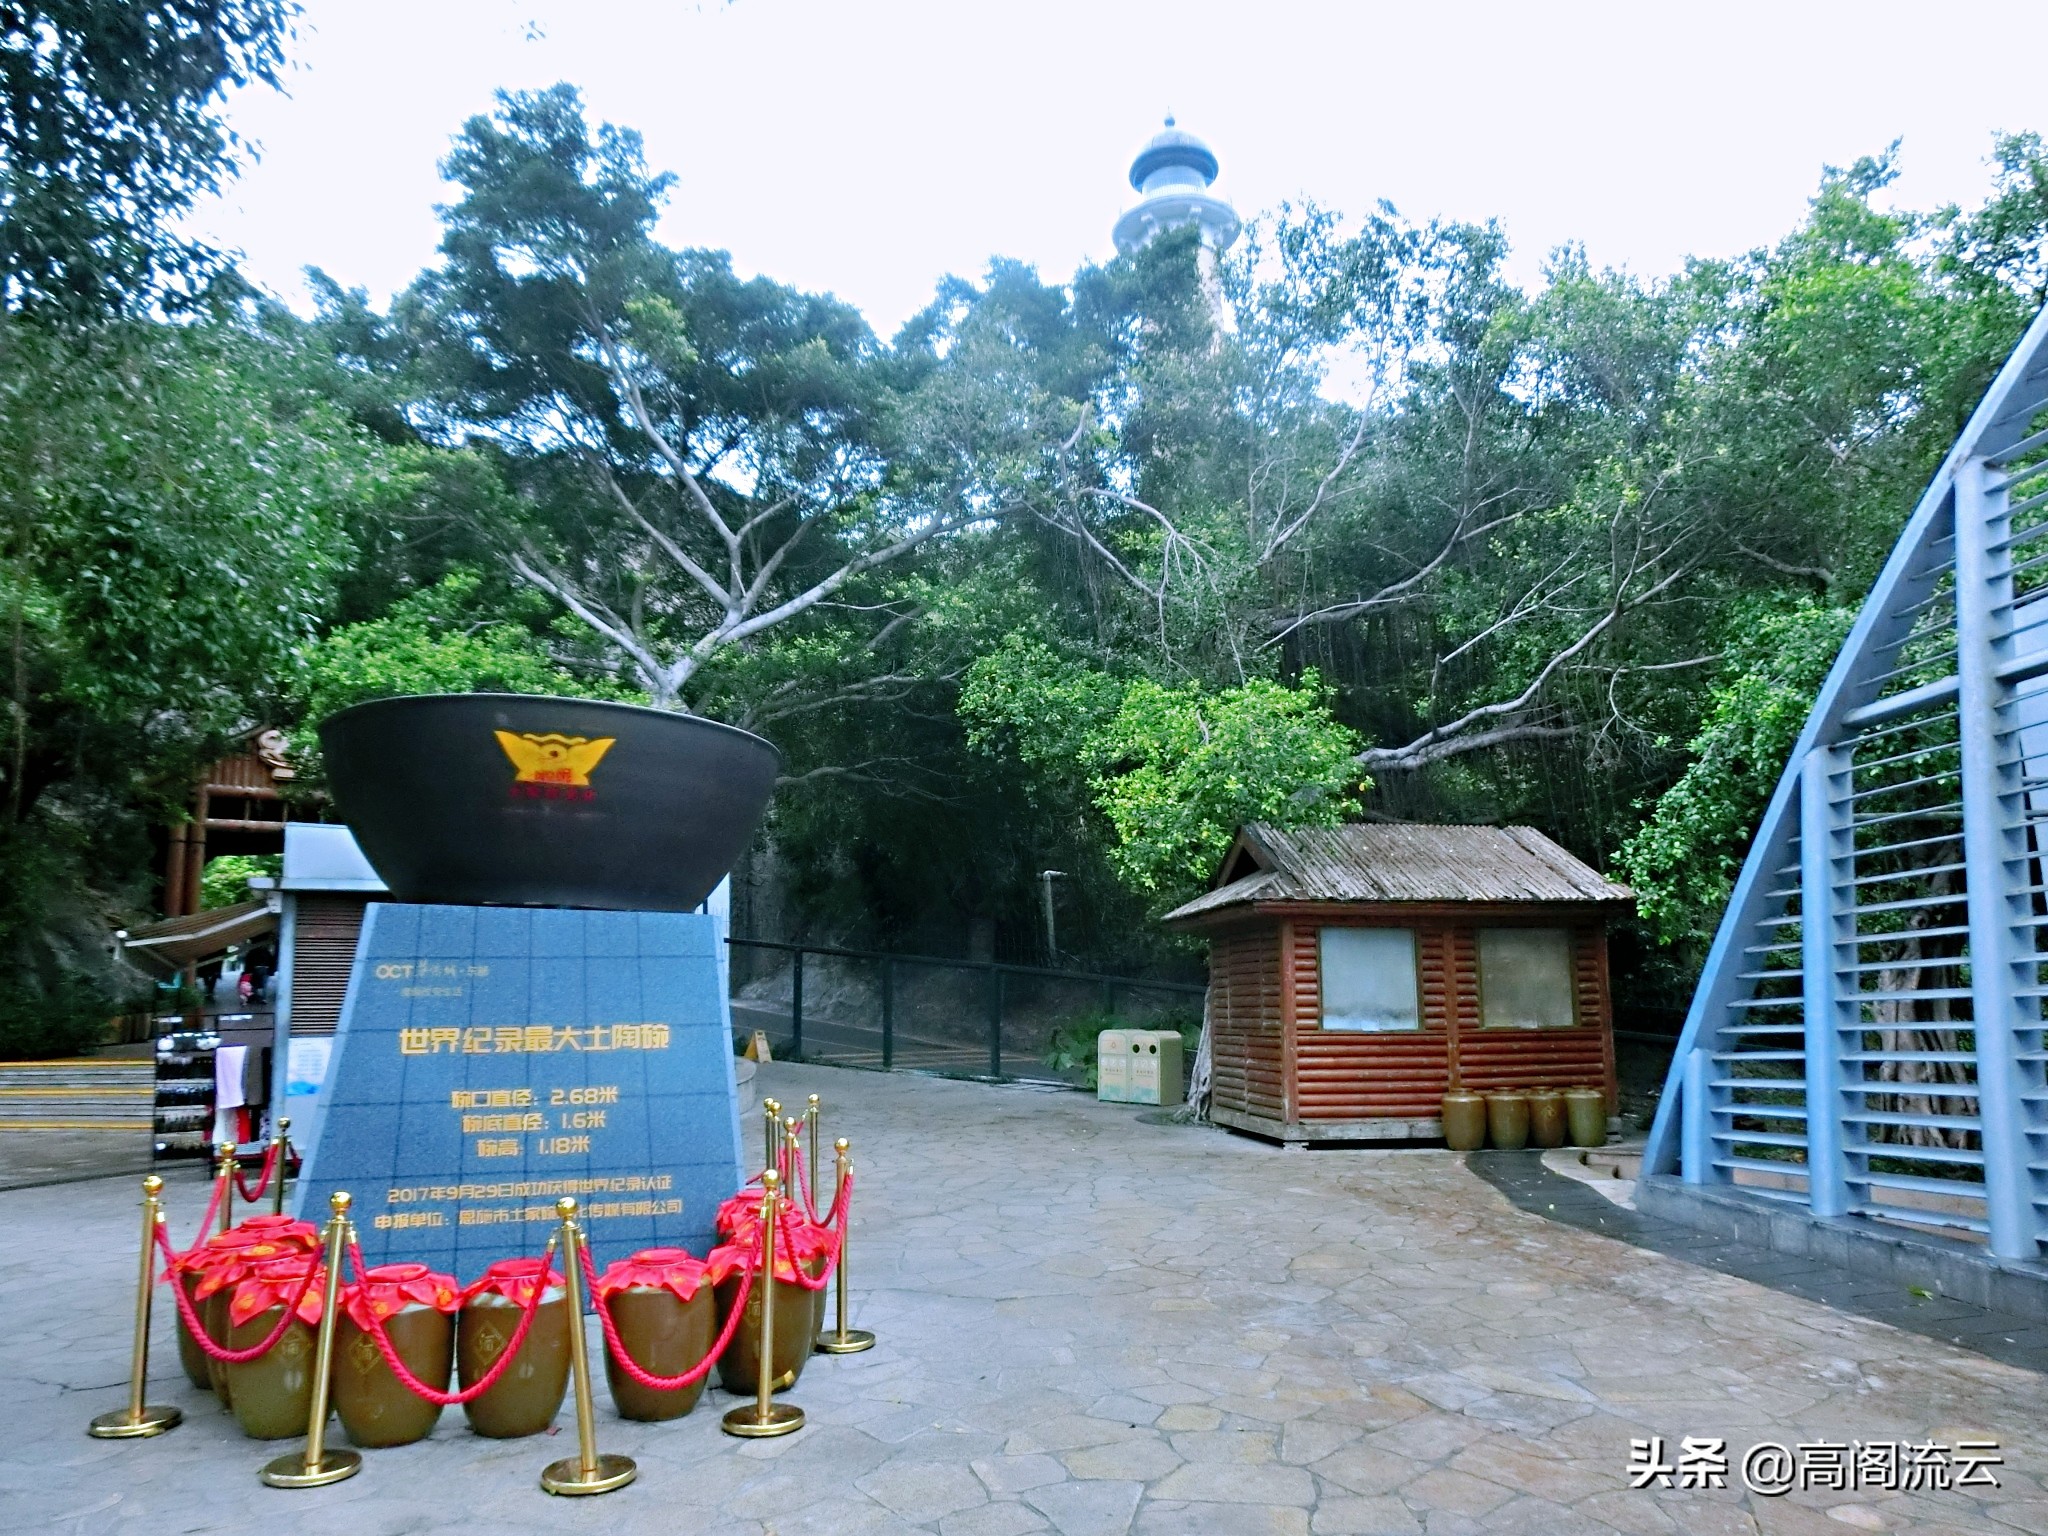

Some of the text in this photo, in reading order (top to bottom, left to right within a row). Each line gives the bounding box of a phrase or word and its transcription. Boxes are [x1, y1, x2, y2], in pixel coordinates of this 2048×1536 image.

[376, 964, 414, 979] OCT
[400, 1023, 670, 1054] 世界纪录最大土陶碗
